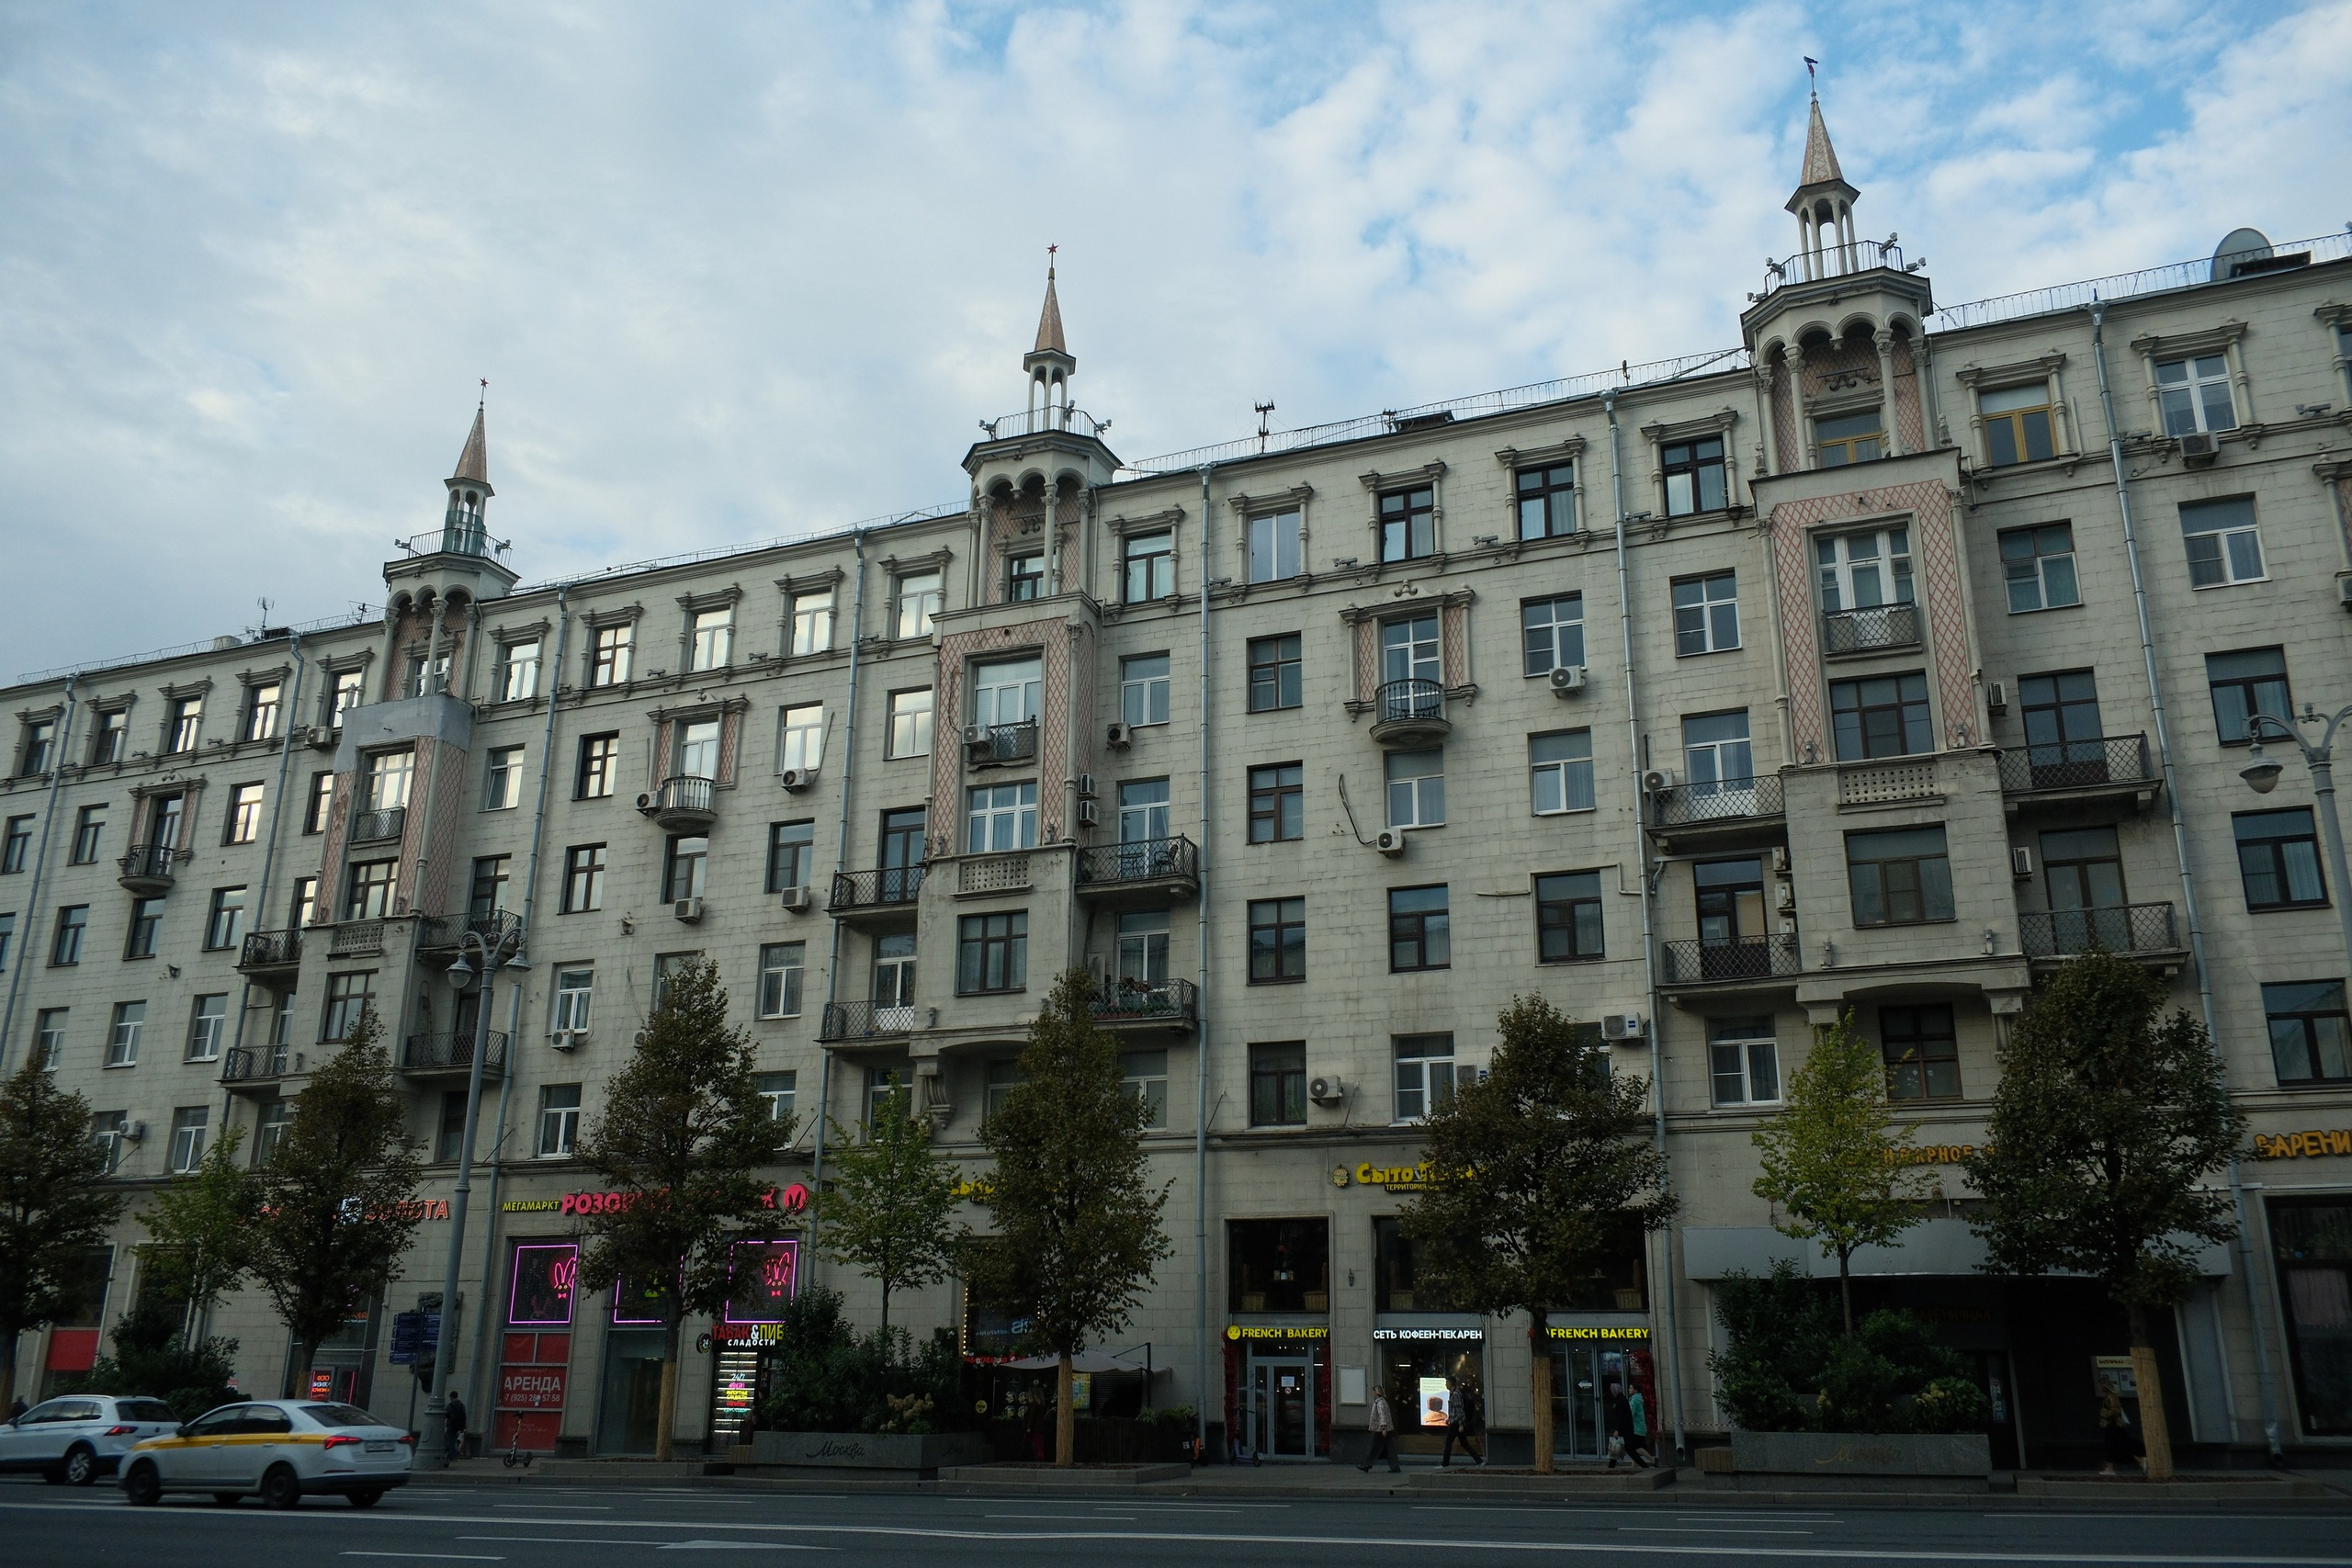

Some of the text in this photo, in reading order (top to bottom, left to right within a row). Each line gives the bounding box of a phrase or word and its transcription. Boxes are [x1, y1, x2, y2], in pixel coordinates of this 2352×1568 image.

[1385, 1183, 1427, 1191] ТЕРРИТОРИЯ
[502, 1201, 560, 1212] МЕГАМАРКТ
[1241, 1327, 1329, 1338] FRENCH BAKERY
[1373, 1329, 1483, 1340] СЕТЬ КОФЕЕН-ПЕКАРЕН
[1550, 1328, 1650, 1338] FRENCH BAKERY
[727, 1338, 776, 1348] СЛАДОСТИ
[503, 1376, 561, 1393] АРЕНДА
[511, 1393, 528, 1403] (925)
[542, 1393, 551, 1402] 57
[551, 1393, 561, 1403] 58
[806, 1440, 865, 1459] Москва
